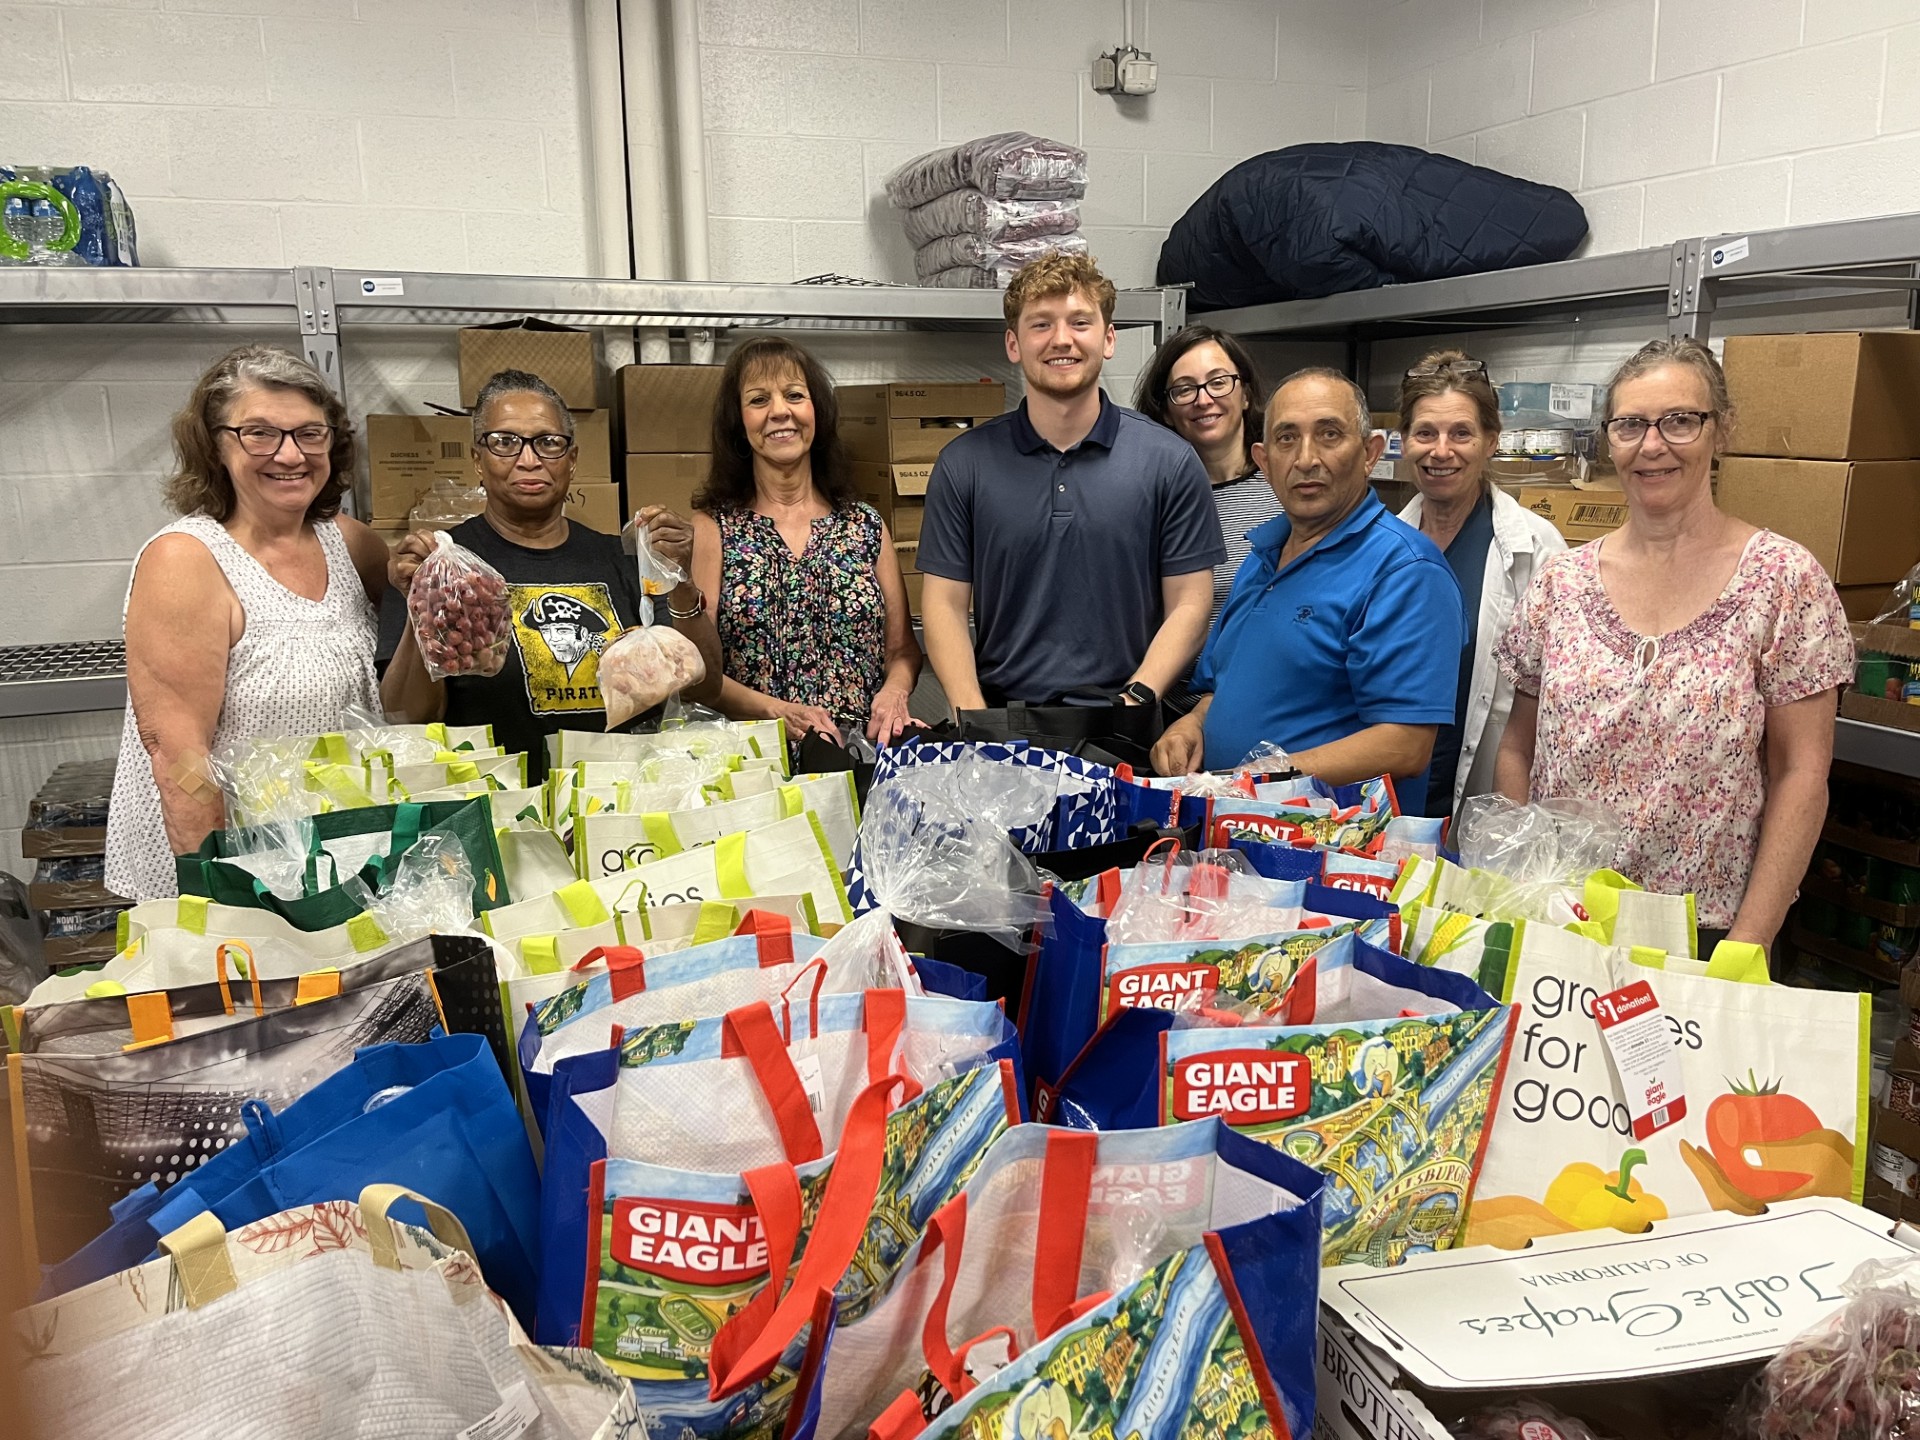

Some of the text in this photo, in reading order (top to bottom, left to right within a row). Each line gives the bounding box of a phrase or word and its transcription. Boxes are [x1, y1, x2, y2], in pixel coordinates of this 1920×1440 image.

[546, 686, 603, 701] PIRAT
[1332, 879, 1392, 902] GIAN
[1118, 970, 1210, 995] GIANT
[1596, 992, 1652, 1022] $1 donation!
[1523, 1022, 1588, 1074] for
[1185, 1060, 1299, 1088] GIANT
[1645, 1081, 1665, 1099] giant
[1187, 1086, 1297, 1114] EAGLE
[1646, 1091, 1667, 1107] eagle
[628, 1206, 766, 1244] GIANT
[629, 1234, 769, 1272] EAGLE
[1518, 1252, 1709, 1288] OF CALIFORNIA
[1682, 1261, 1846, 1324] Table
[1459, 1288, 1683, 1339] Grapes
[1142, 1347, 1178, 1428] Allegheny
[1322, 1335, 1413, 1440] BROTH
